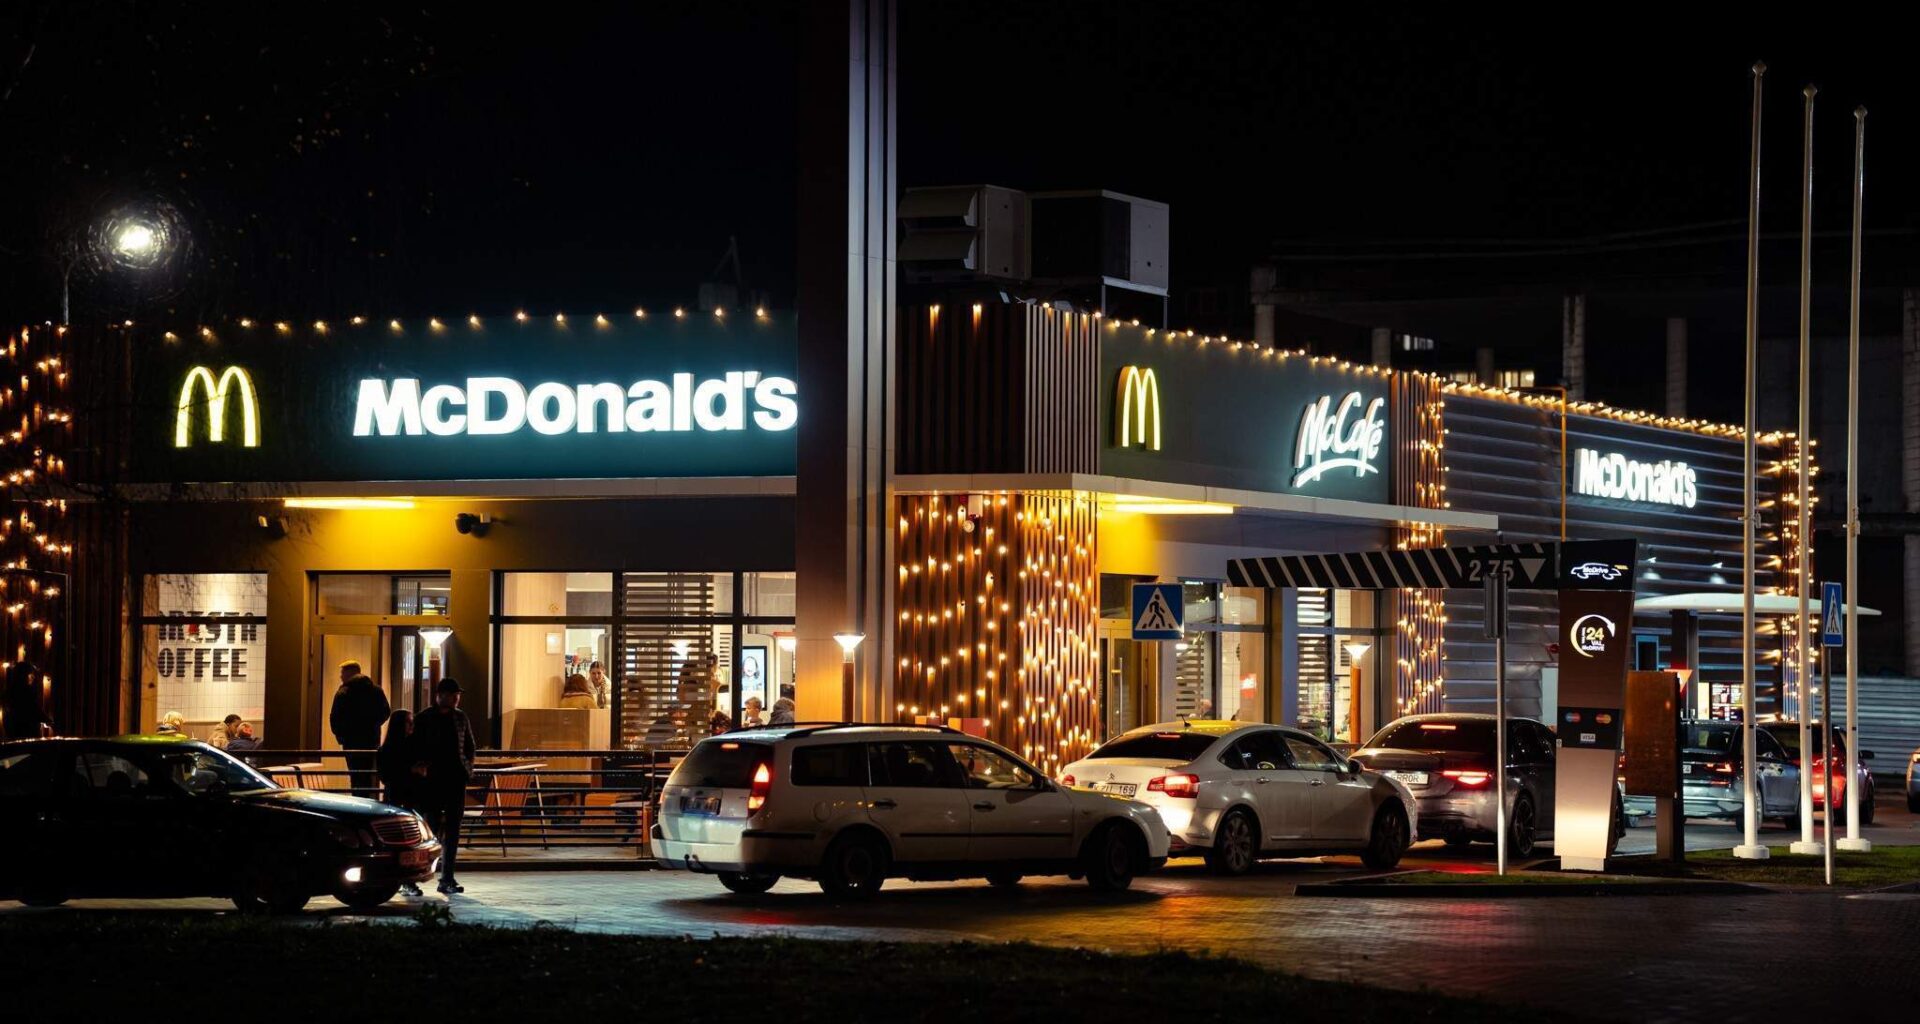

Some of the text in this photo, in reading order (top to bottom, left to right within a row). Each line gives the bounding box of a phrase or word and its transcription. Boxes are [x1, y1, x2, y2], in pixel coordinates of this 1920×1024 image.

[353, 370, 799, 436] McDonald's
[1293, 391, 1385, 485] McCafé
[1574, 447, 1697, 508] McDonald's
[158, 648, 248, 677] OFFEE
[1586, 626, 1604, 640] 24
